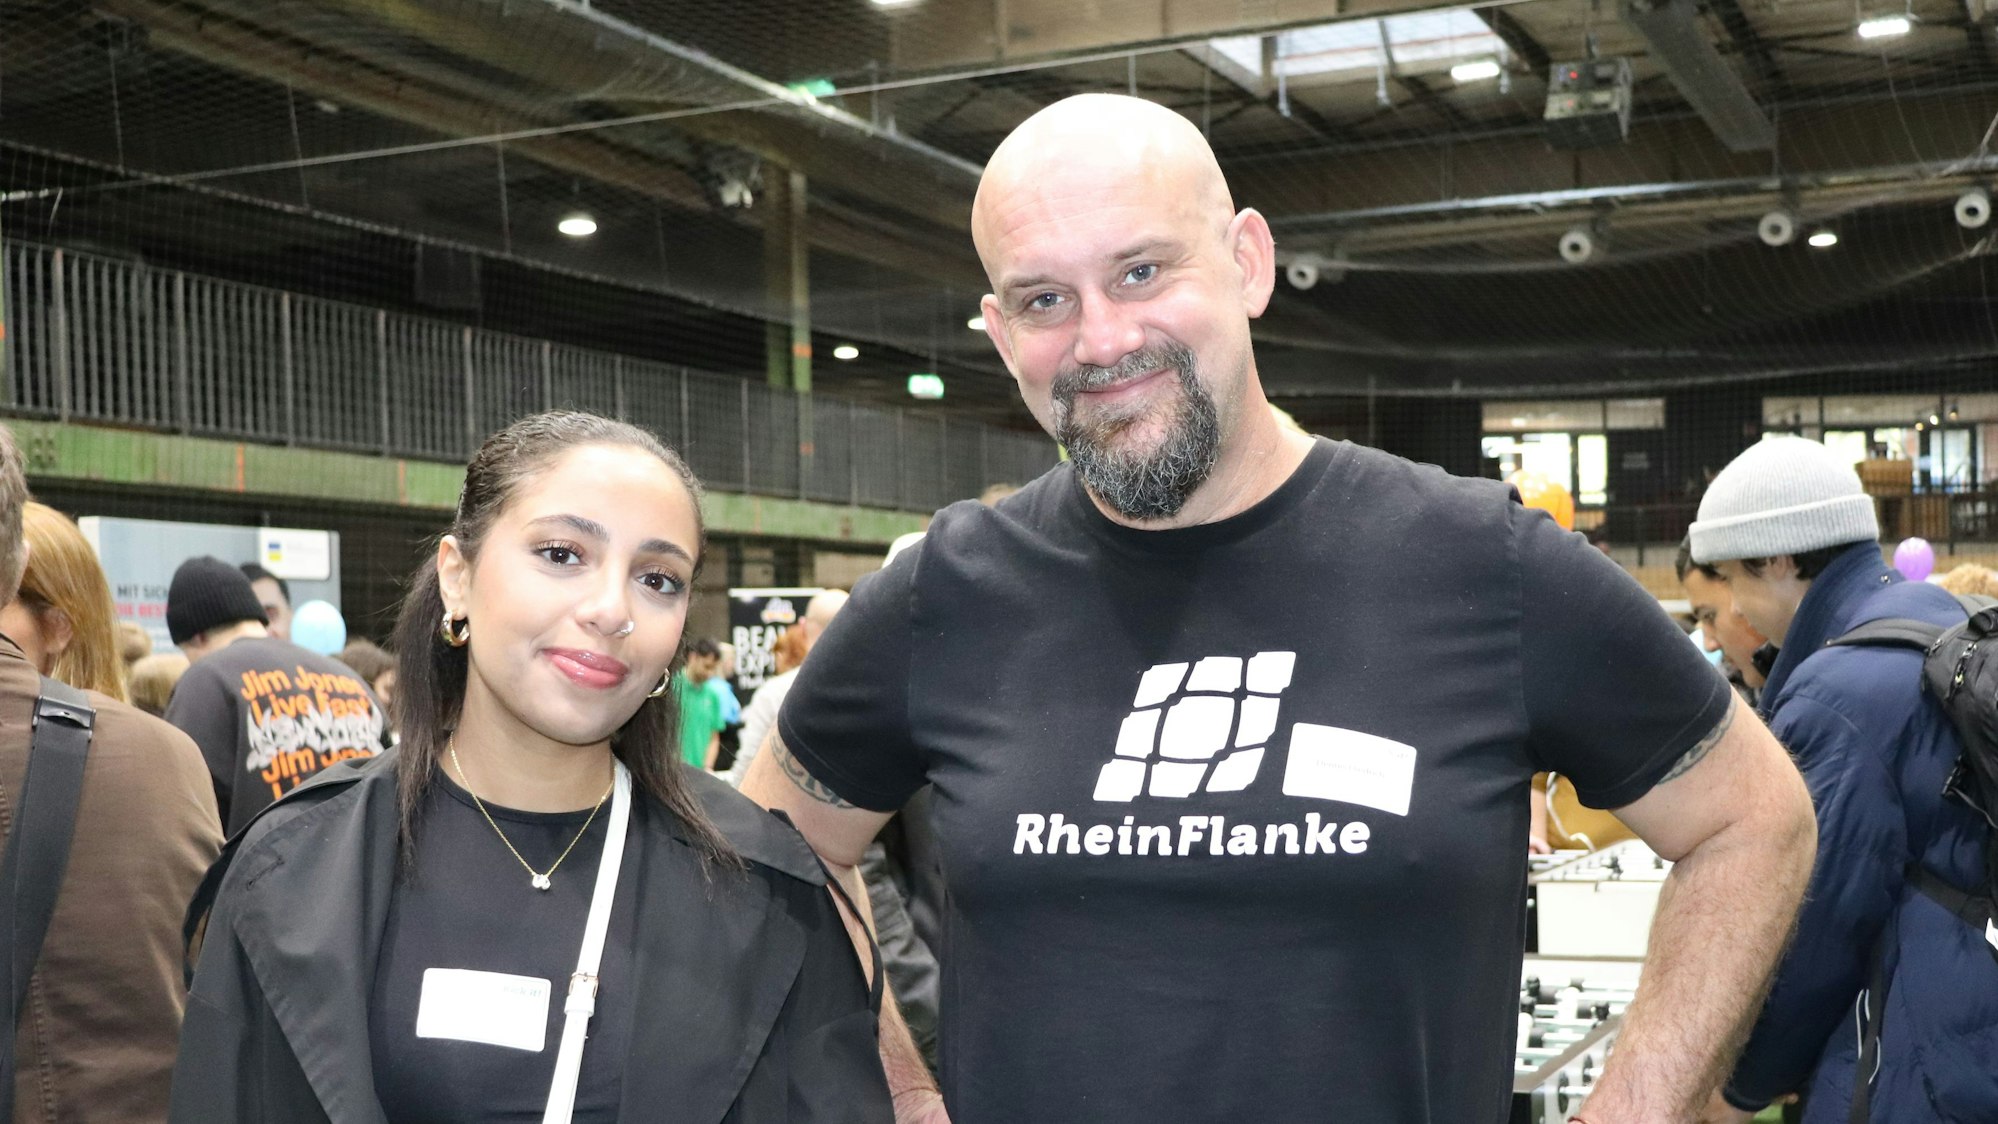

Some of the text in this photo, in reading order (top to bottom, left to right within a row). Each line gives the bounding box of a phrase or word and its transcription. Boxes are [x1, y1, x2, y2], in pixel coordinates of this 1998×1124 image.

[117, 584, 138, 598] MIT
[733, 625, 786, 653] BEA
[240, 669, 292, 701] Jim
[250, 690, 373, 730] Live Fast
[262, 747, 316, 784] Jim
[1013, 812, 1371, 857] RheinFlanke
